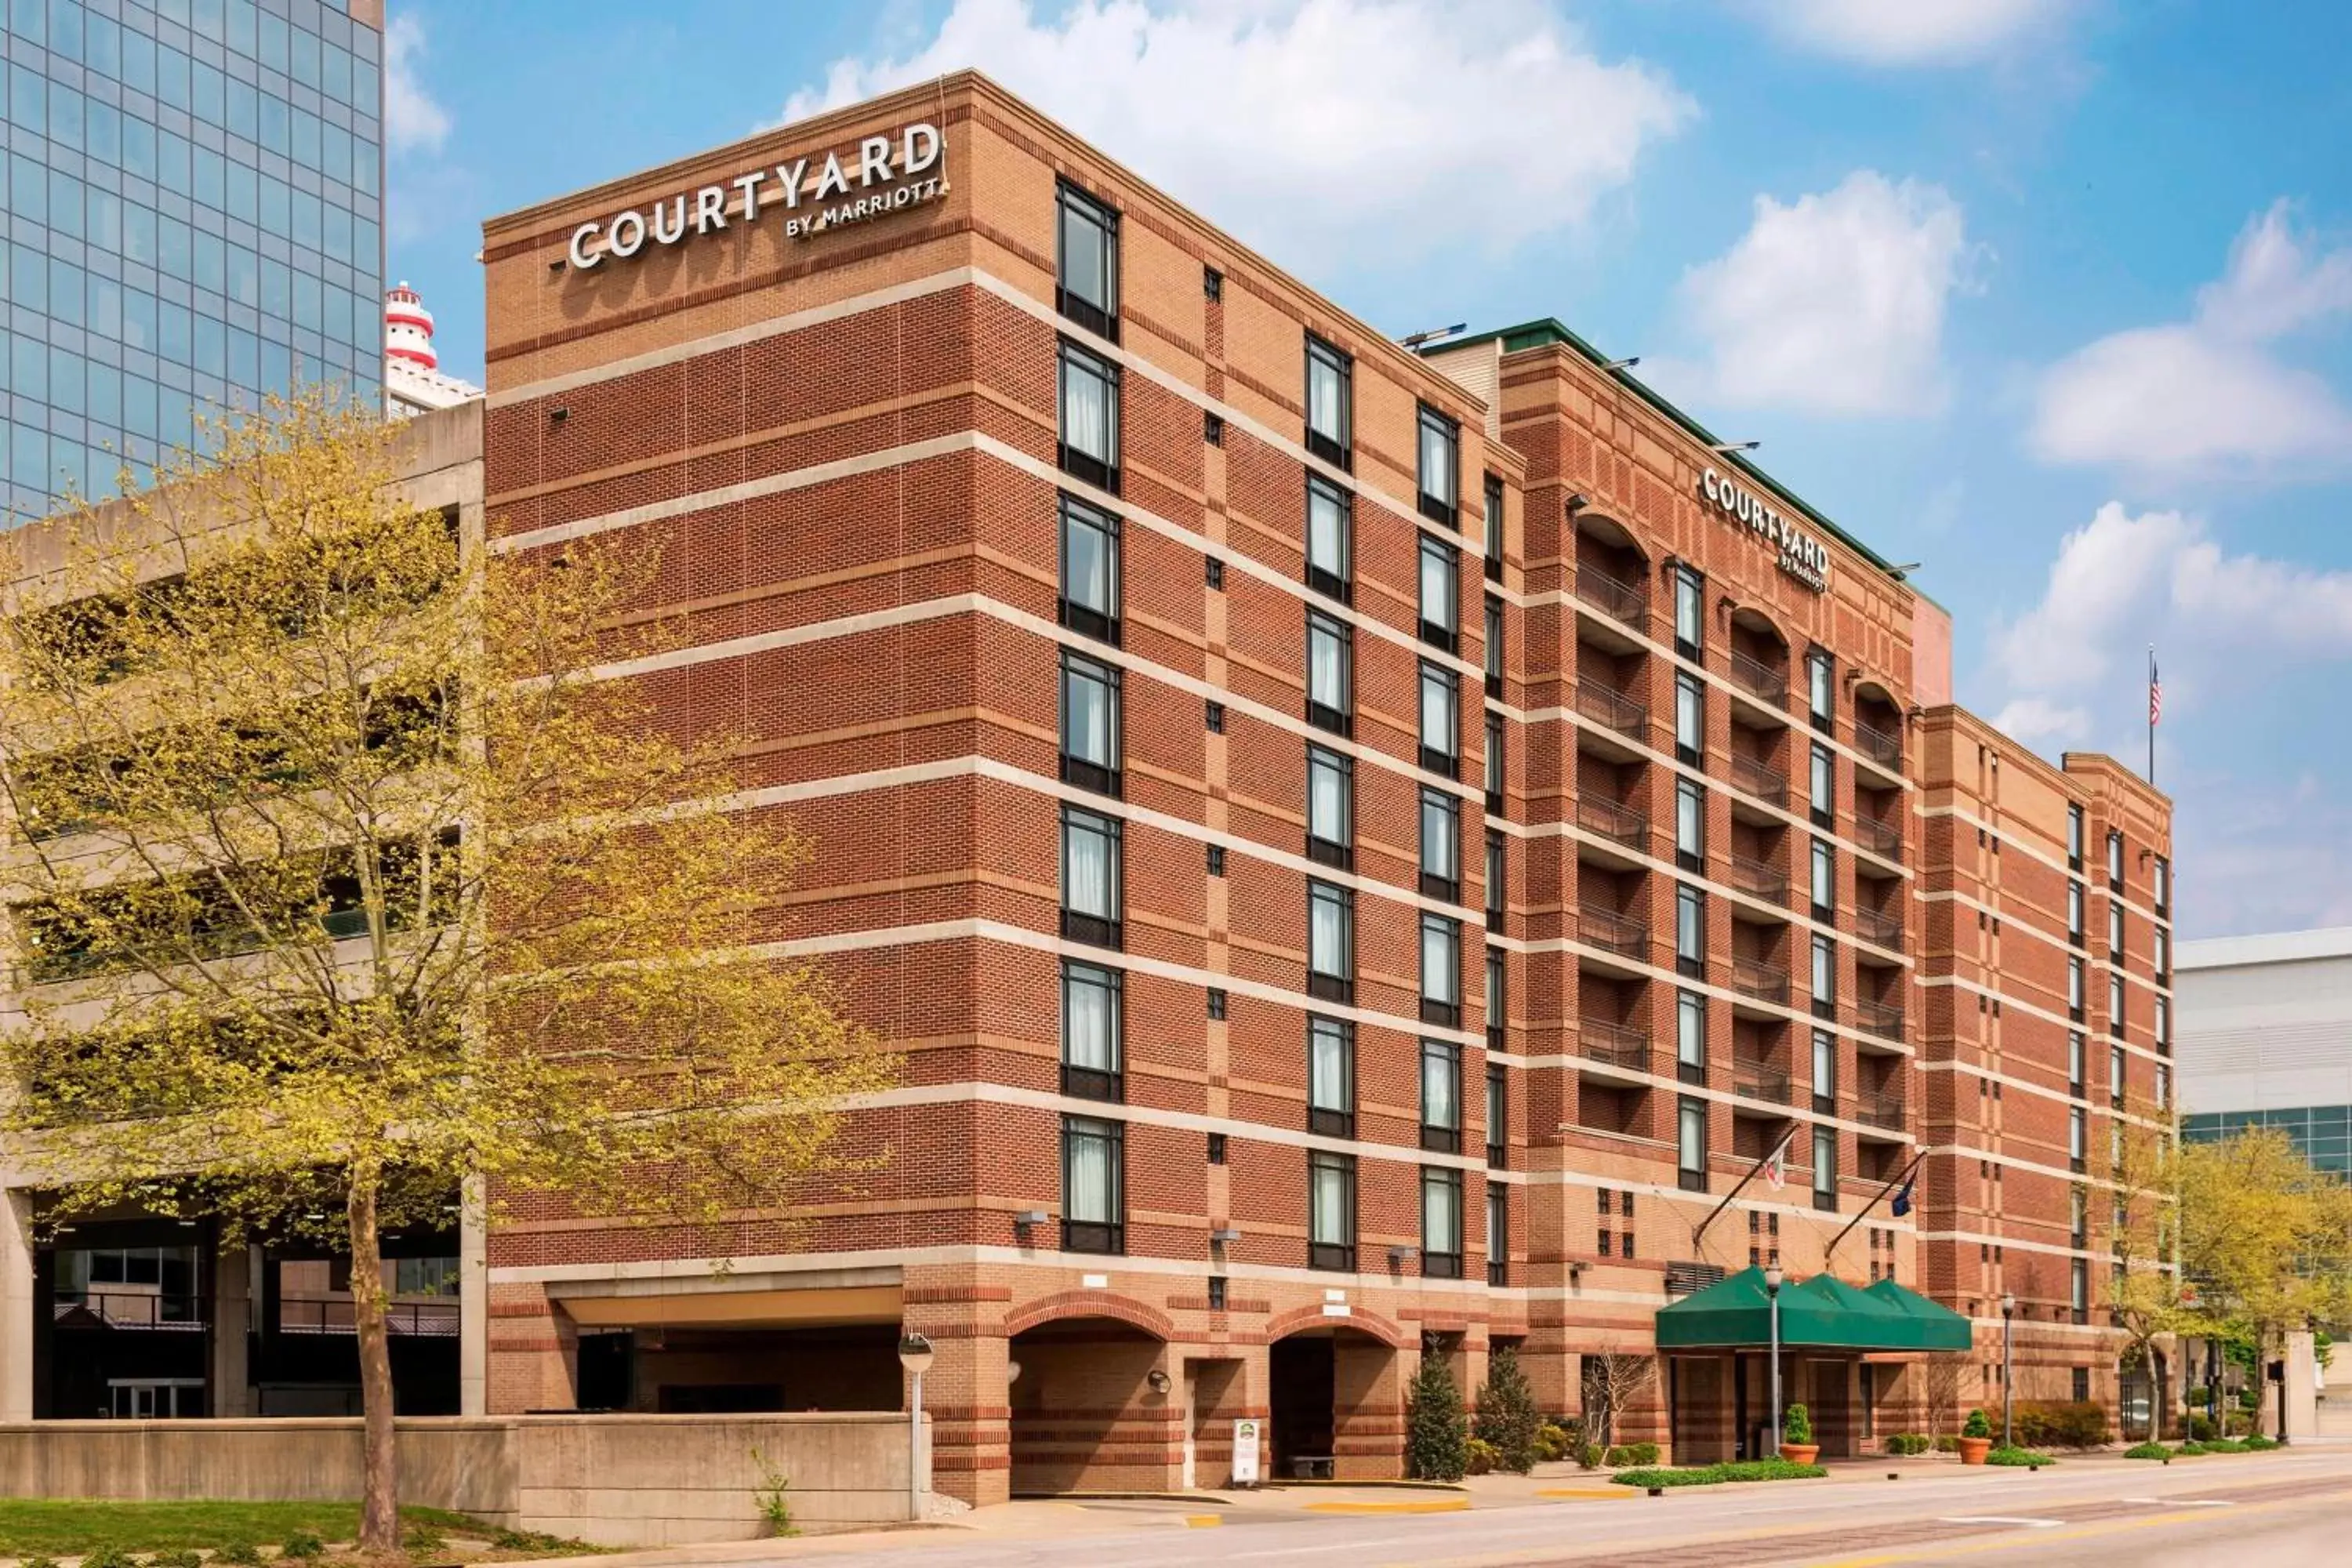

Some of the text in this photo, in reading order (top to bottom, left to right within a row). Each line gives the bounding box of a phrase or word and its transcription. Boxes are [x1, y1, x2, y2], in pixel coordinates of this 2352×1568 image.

[569, 123, 939, 269] COURTYARD
[786, 178, 938, 236] BY MARRIOTT
[1704, 468, 1828, 574] COURTYARD
